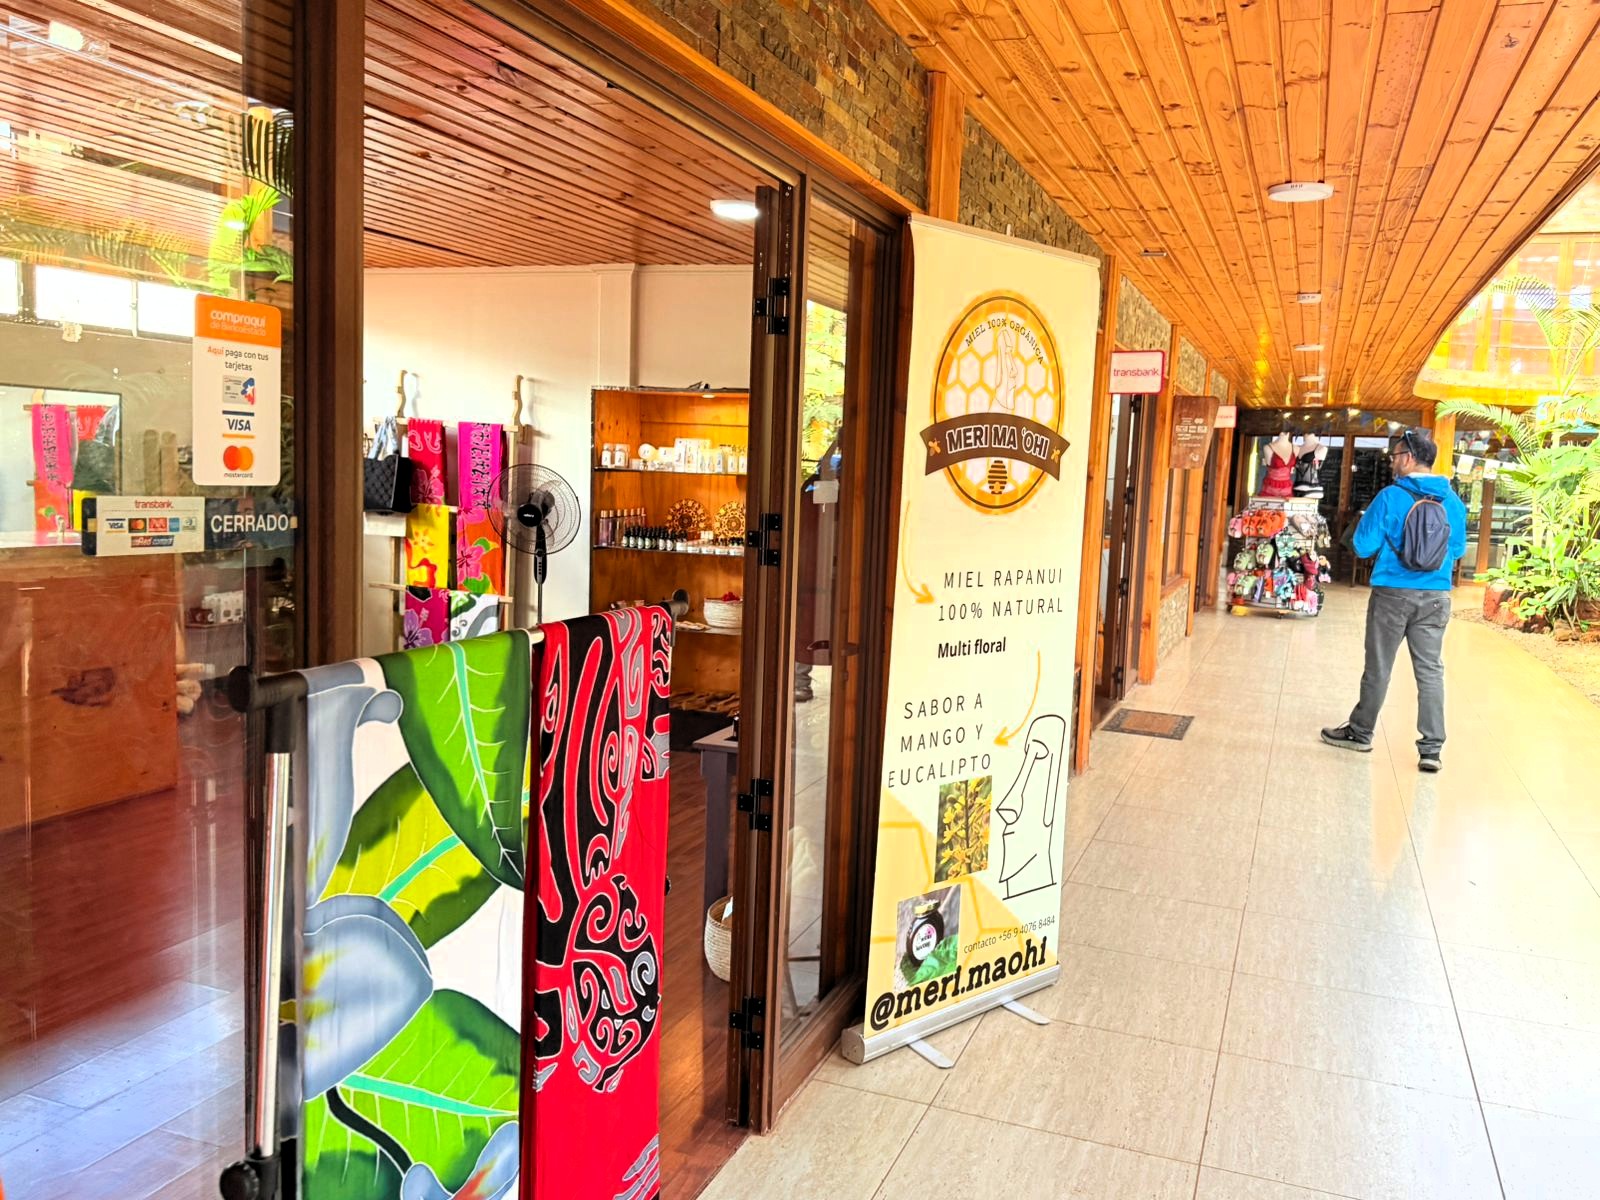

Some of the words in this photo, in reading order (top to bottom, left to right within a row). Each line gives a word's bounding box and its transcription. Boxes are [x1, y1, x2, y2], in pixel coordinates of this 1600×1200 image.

[965, 324, 986, 347] MIEL
[987, 318, 1007, 329] 100%
[1009, 320, 1044, 365] ORGÁNICA
[224, 361, 252, 372] tarjetas
[225, 349, 242, 358] paga
[257, 353, 269, 361] tus
[226, 418, 251, 431] VISA
[946, 425, 989, 454] MERI
[992, 425, 1018, 450] MA
[210, 514, 289, 533] CERRADO
[944, 571, 984, 589] MIEL
[993, 568, 1062, 586] RAPANUI
[938, 602, 983, 622] 100%
[992, 597, 1063, 617] NATURAL
[937, 640, 971, 659] Multi
[974, 636, 1006, 655] floral
[903, 695, 965, 720] SABOR
[973, 692, 983, 709] A
[900, 726, 966, 753] MANGO
[975, 723, 983, 741] Y
[888, 753, 991, 789] EUCALIPTO
[963, 937, 997, 954] contacto
[998, 928, 1012, 942] +56
[1013, 927, 1019, 938] 9
[1019, 921, 1037, 934] 4076
[1038, 914, 1055, 930] 8484
